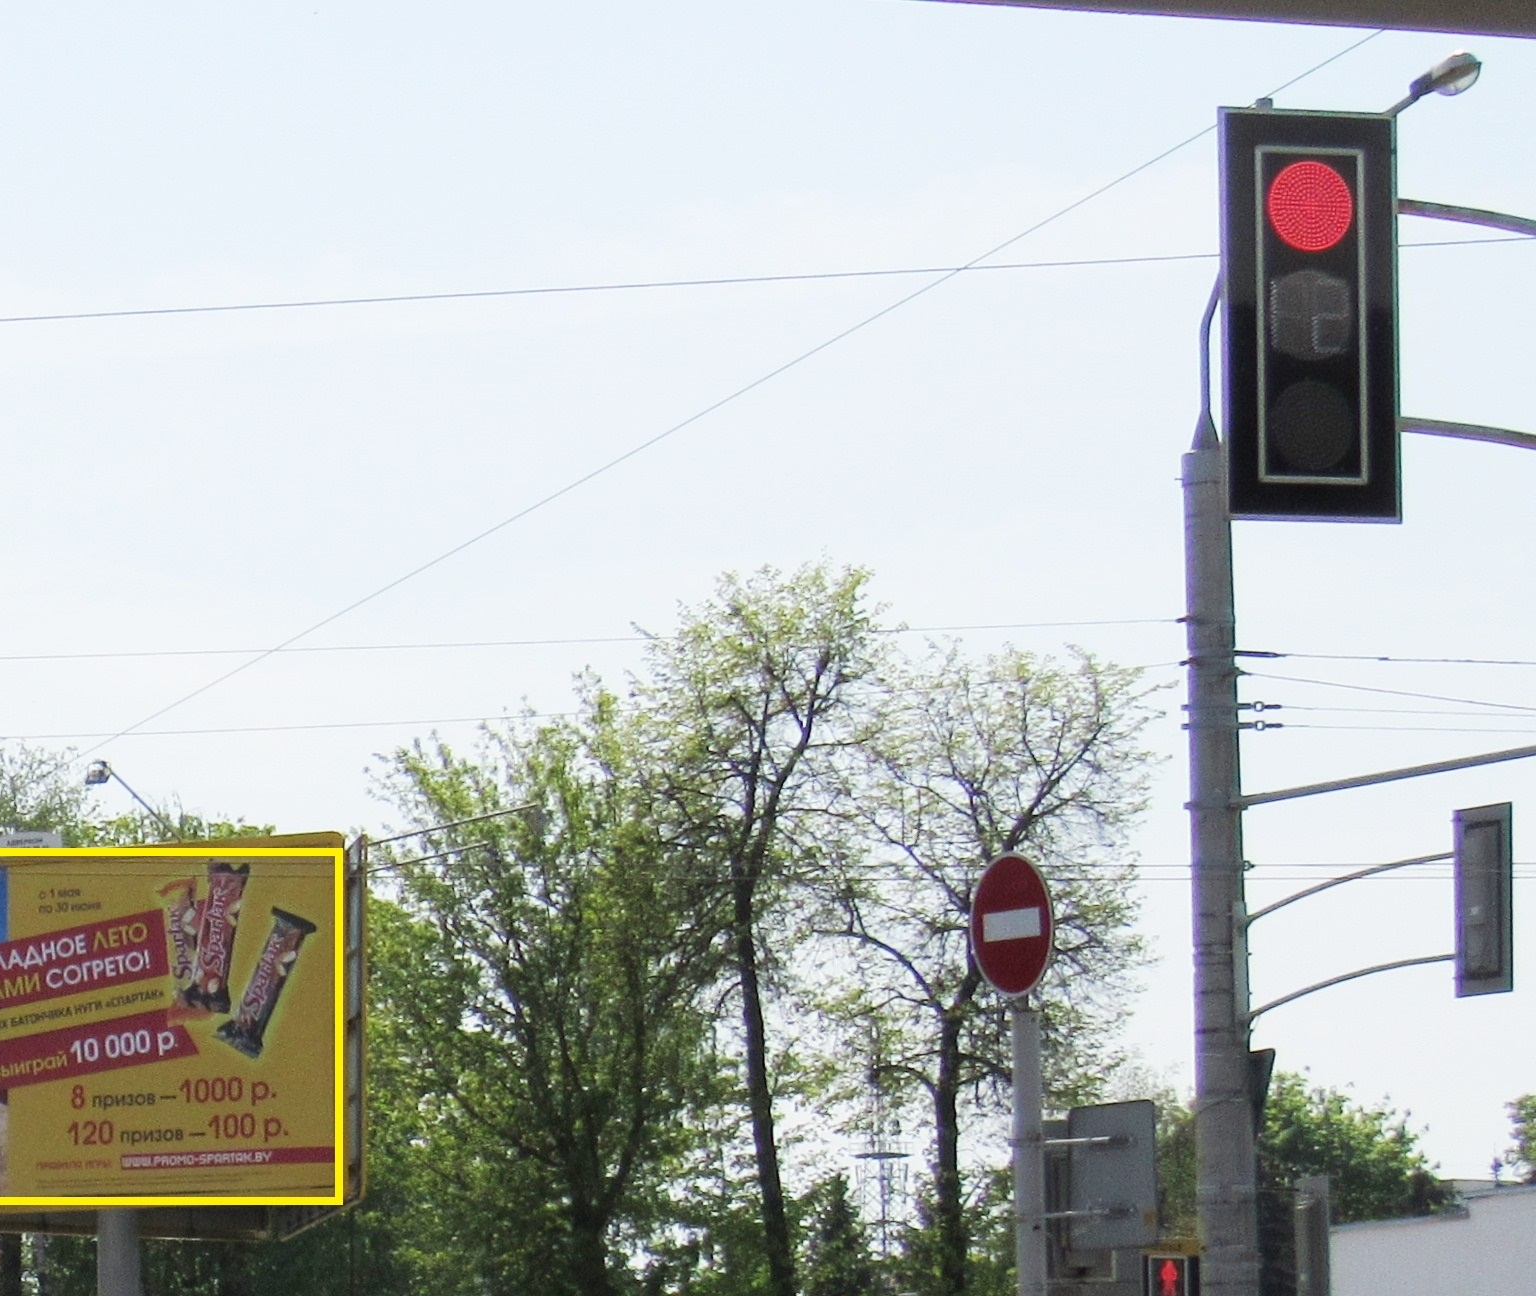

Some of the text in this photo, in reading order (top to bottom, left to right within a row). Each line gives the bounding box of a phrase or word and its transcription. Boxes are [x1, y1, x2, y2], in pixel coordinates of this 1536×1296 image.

[55, 900, 69, 913] 30
[92, 921, 148, 952] ЛЕТО
[45, 949, 151, 989] СОГРЕТО!
[74, 1000, 103, 1016] НУГИ
[71, 1084, 86, 1110] 8
[91, 1091, 156, 1111] призов
[179, 1076, 244, 1104] 1000
[67, 1119, 114, 1146] 120
[120, 1127, 184, 1145] призов
[208, 1112, 256, 1140] 100
[121, 1150, 273, 1168] WWW.PROMO-SPARTAK.BY
